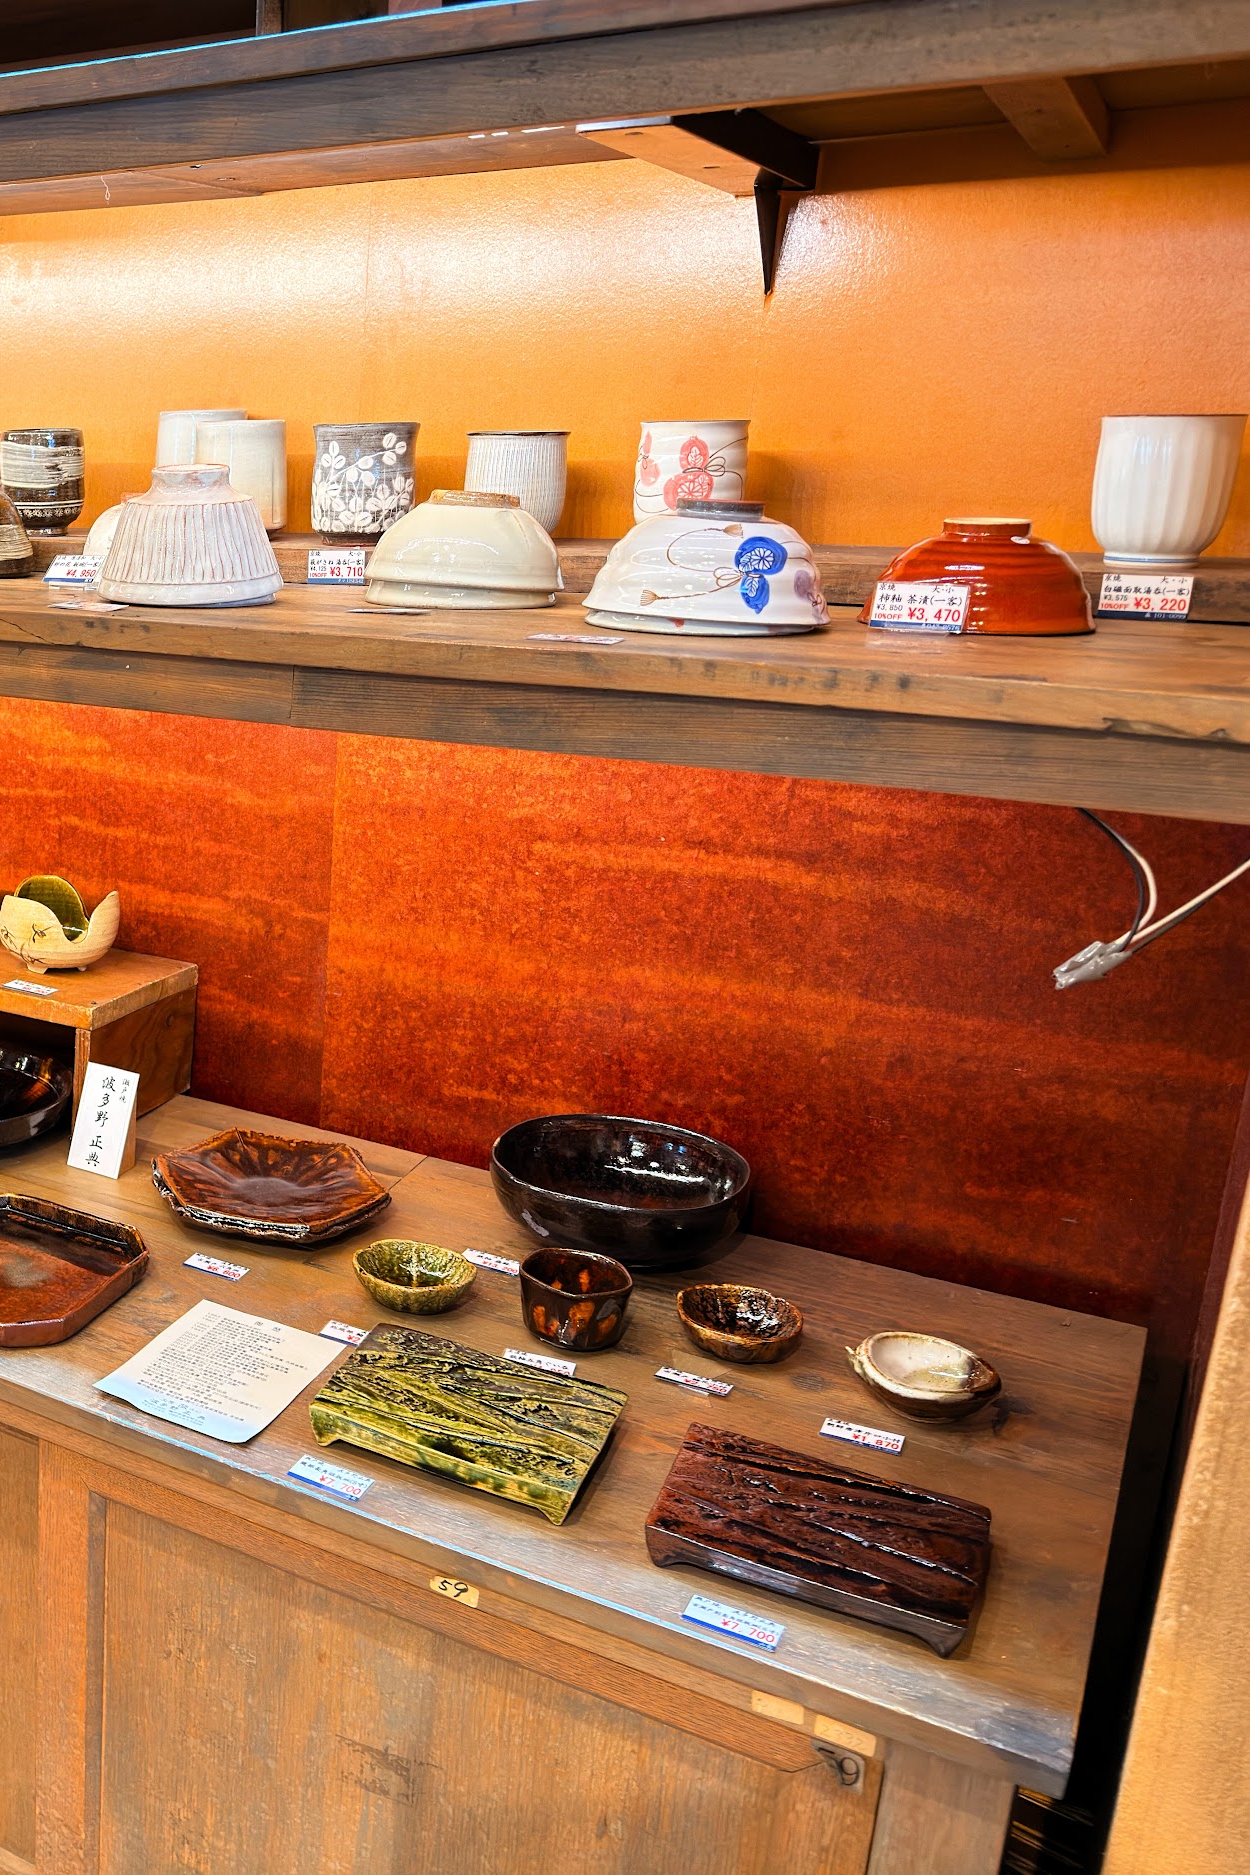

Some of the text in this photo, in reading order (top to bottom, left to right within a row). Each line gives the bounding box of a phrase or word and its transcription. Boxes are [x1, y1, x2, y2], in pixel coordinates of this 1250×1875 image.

[66, 569, 97, 578] ¥4,950
[330, 566, 363, 578] ¥3,710
[876, 603, 903, 612] ¥3,850
[1134, 596, 1187, 612] ¥3,220
[874, 612, 904, 620] 10%OFF
[907, 606, 962, 622] ¥3,470
[852, 1432, 900, 1450] ¥1,870
[319, 1474, 362, 1496] ¥7,700
[438, 1579, 469, 1598] 59
[721, 1618, 776, 1643] ¥7,700
